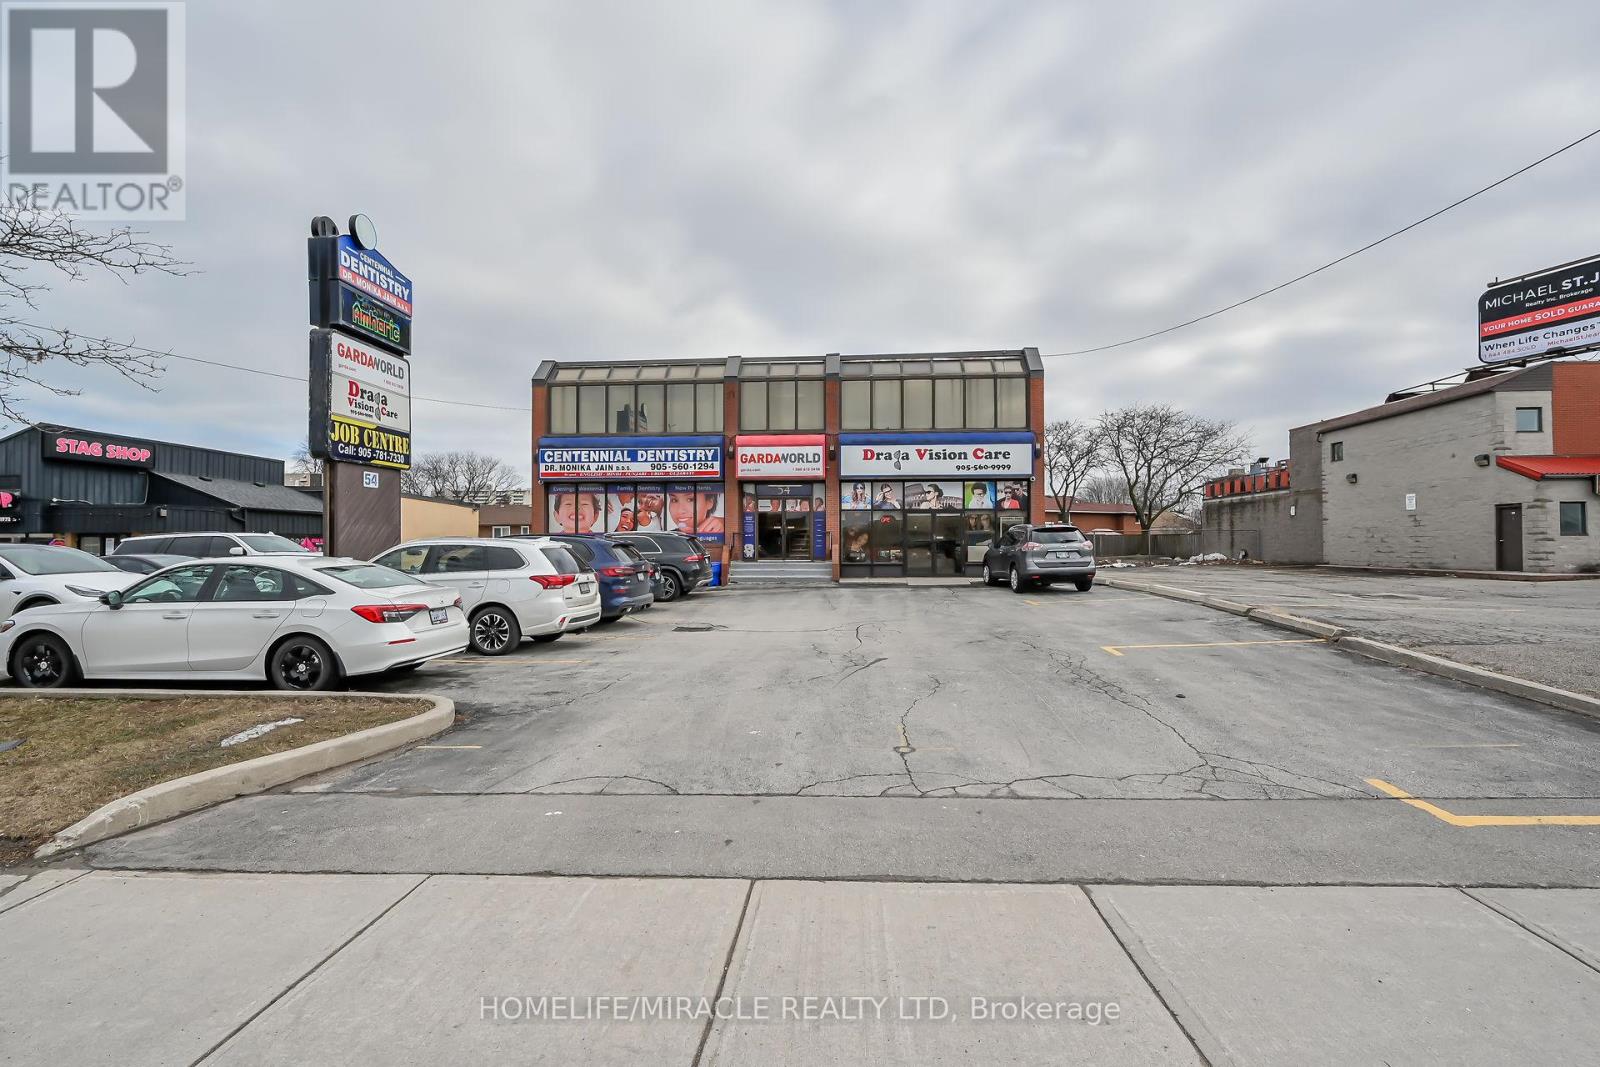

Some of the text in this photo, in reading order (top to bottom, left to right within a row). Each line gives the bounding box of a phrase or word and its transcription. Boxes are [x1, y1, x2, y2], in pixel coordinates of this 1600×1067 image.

[340, 250, 410, 301] DENTISTRY
[360, 252, 394, 278] CENTENNIAL
[342, 269, 355, 283] DR.
[356, 276, 382, 298] MONIKA
[383, 292, 397, 306] JAIN
[1485, 284, 1558, 310] MICHAEL
[1525, 299, 1544, 308] Realty
[1559, 287, 1594, 299] Brokerage
[1483, 322, 1506, 333] YOUR
[1507, 317, 1532, 327] HOME
[1534, 308, 1565, 321] SOLD
[1484, 323, 1596, 352] When Life Changes
[337, 343, 404, 380] GARDAWORLD
[348, 397, 398, 419] Vision Care
[56, 437, 151, 462] STAG SHOP
[330, 421, 410, 455] JOB CENTRE
[338, 443, 357, 456] Call:
[544, 450, 714, 463] CENTENNIAL DENTISTRY
[741, 453, 820, 464] GARDAWORLD
[915, 449, 968, 461] Vision
[972, 447, 1011, 461] Care
[364, 473, 378, 487] 54
[544, 464, 558, 472] DR.
[559, 464, 592, 472] MONIKA
[594, 464, 613, 472] JAIN
